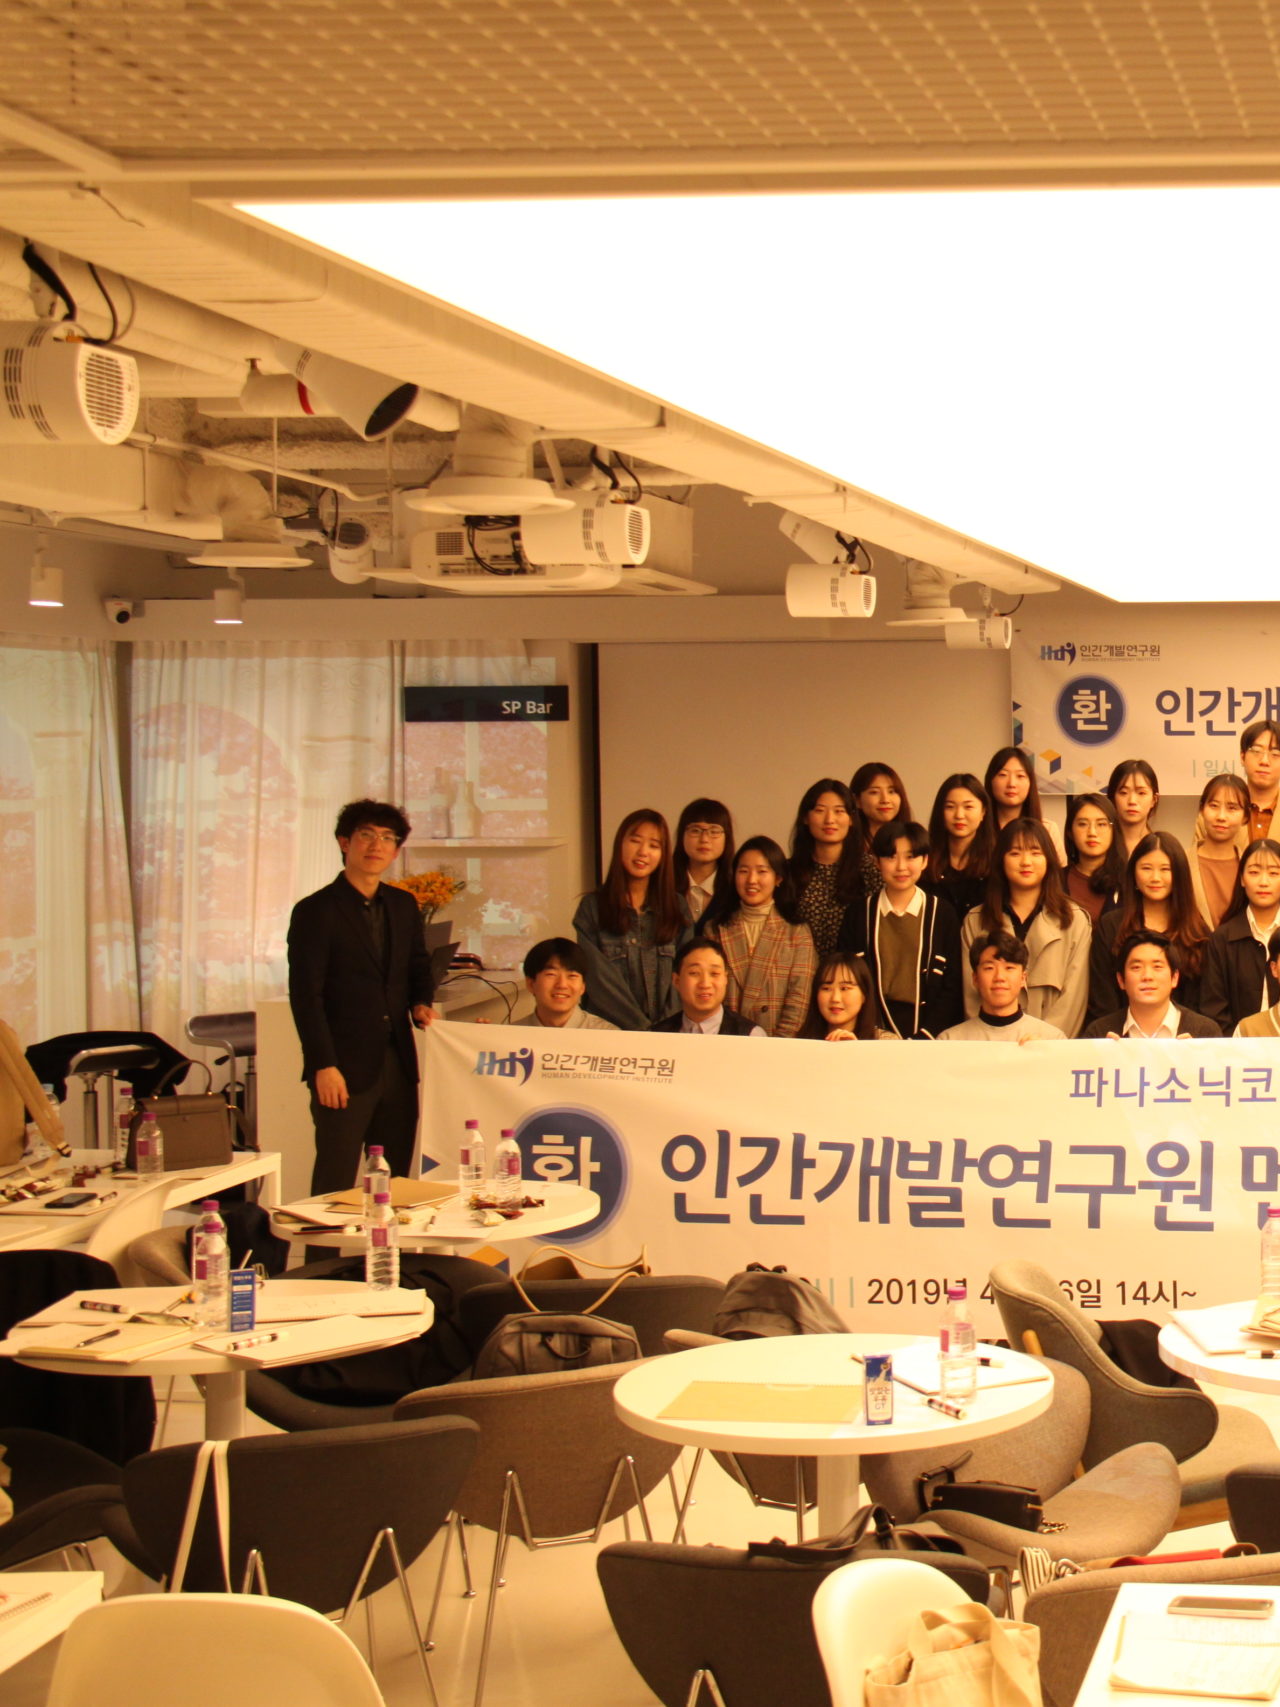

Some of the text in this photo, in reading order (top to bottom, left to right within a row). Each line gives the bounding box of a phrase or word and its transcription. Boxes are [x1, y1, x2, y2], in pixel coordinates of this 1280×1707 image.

[1080, 645, 1160, 657] 인간개발연구원
[502, 701, 552, 714] SP Bar
[1071, 688, 1111, 731] 환
[1203, 759, 1237, 777] 일시
[541, 1053, 676, 1077] 인간개발연구원
[541, 1072, 673, 1084] HUMAN DEVELOPMENT INSTITUTE
[661, 1129, 1215, 1233] 인간개발연구원
[1058, 1278, 1102, 1309] 6일
[1115, 1279, 1197, 1309] 14시~
